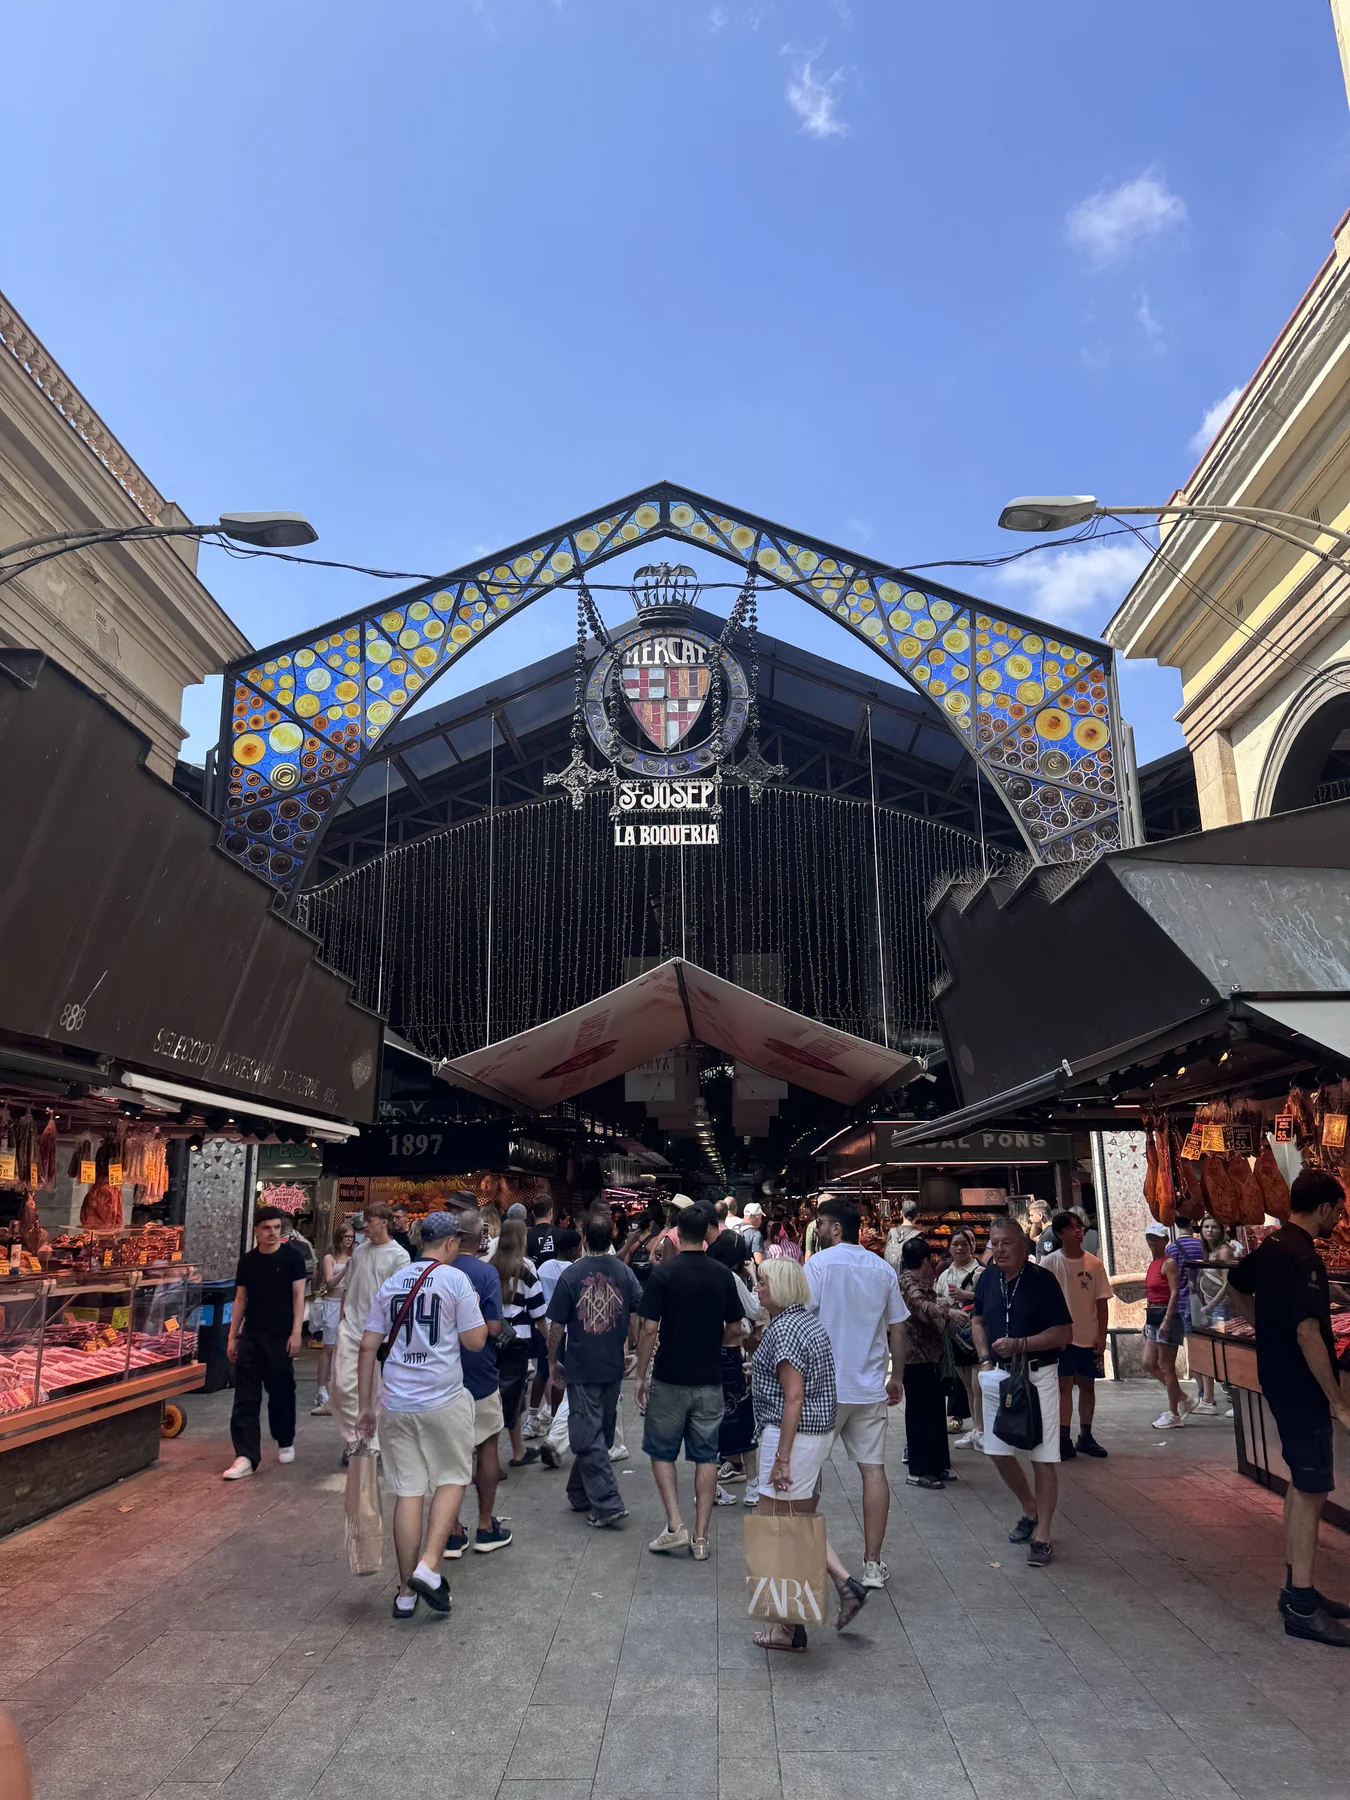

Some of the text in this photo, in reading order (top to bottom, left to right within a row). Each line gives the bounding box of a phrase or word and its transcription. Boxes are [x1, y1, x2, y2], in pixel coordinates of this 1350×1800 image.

[625, 637, 707, 665] MERCAT
[641, 781, 714, 809] JOSEP
[614, 823, 720, 846] LA BOQUERIA
[60, 1003, 87, 1031] 888
[388, 1133, 444, 1157] 1897
[982, 1133, 1046, 1148] PONS
[390, 1293, 442, 1348] 94
[746, 1575, 822, 1621] ZARA
